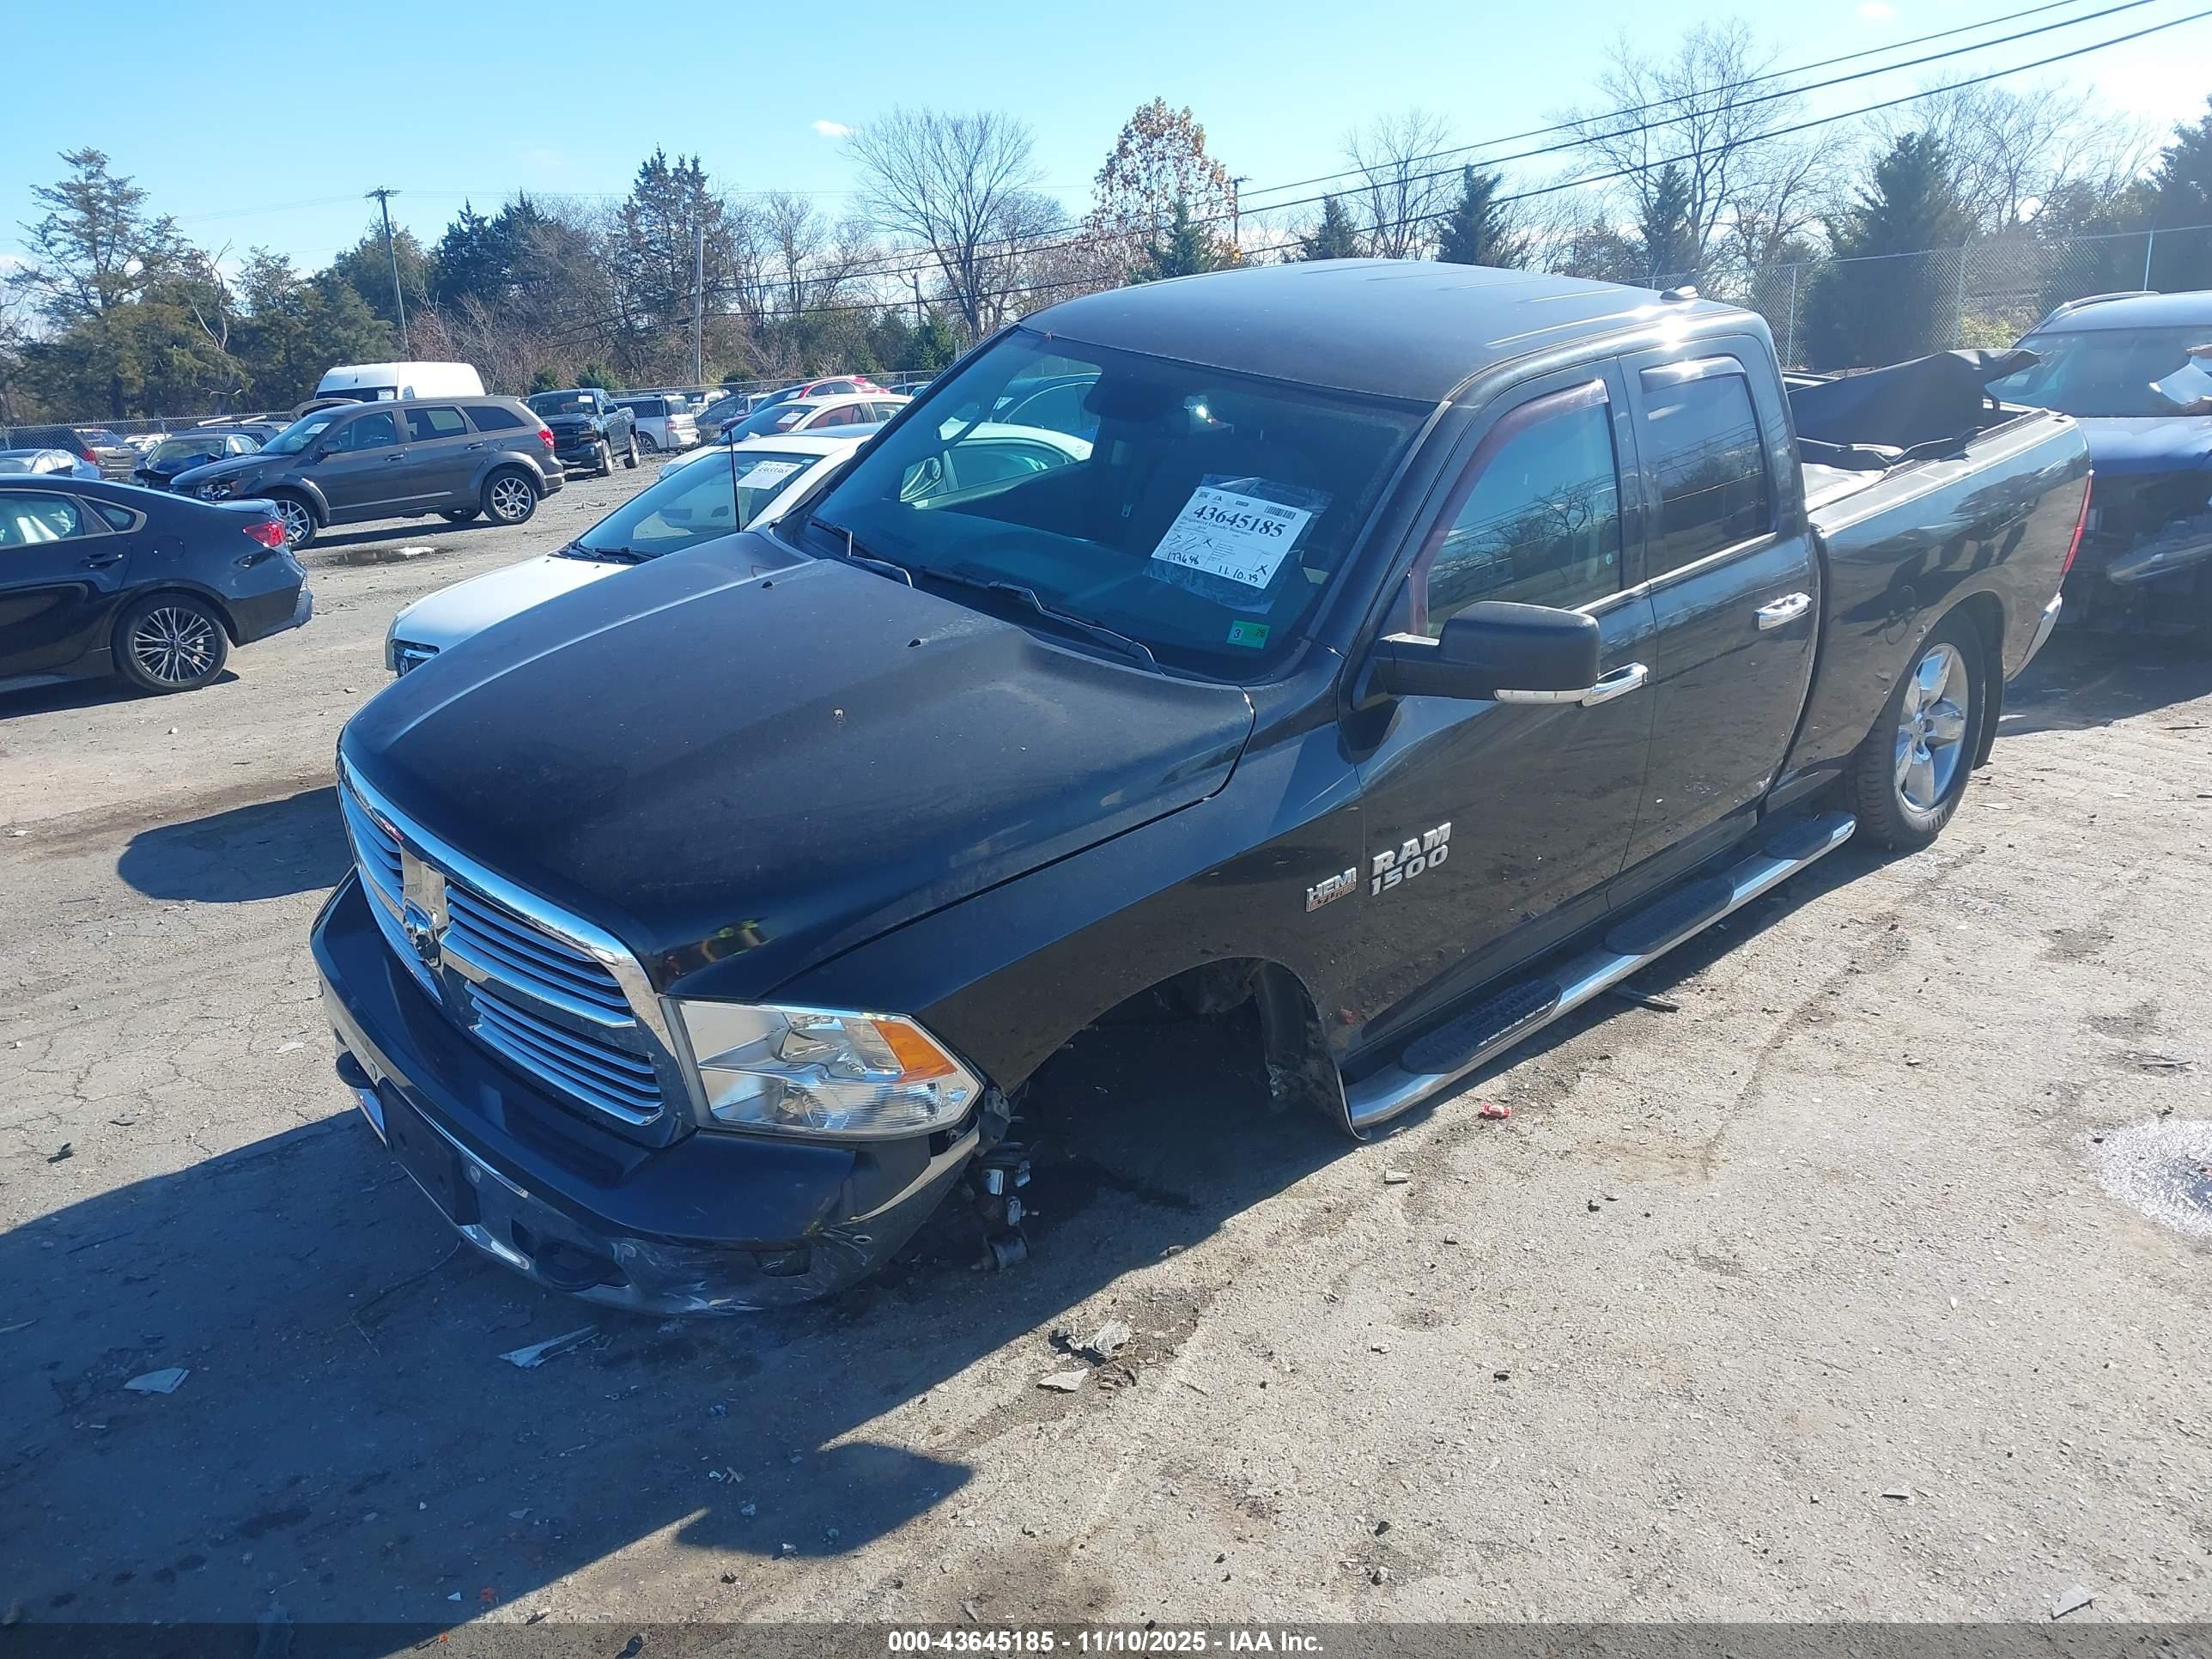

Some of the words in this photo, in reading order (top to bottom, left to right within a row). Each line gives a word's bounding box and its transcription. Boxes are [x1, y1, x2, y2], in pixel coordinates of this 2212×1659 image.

[1193, 505, 1286, 537] 43645185
[1234, 629, 1241, 639] 3
[1372, 822, 1451, 877] RAM
[1306, 866, 1357, 902] HEMI
[1371, 844, 1449, 896] 1500
